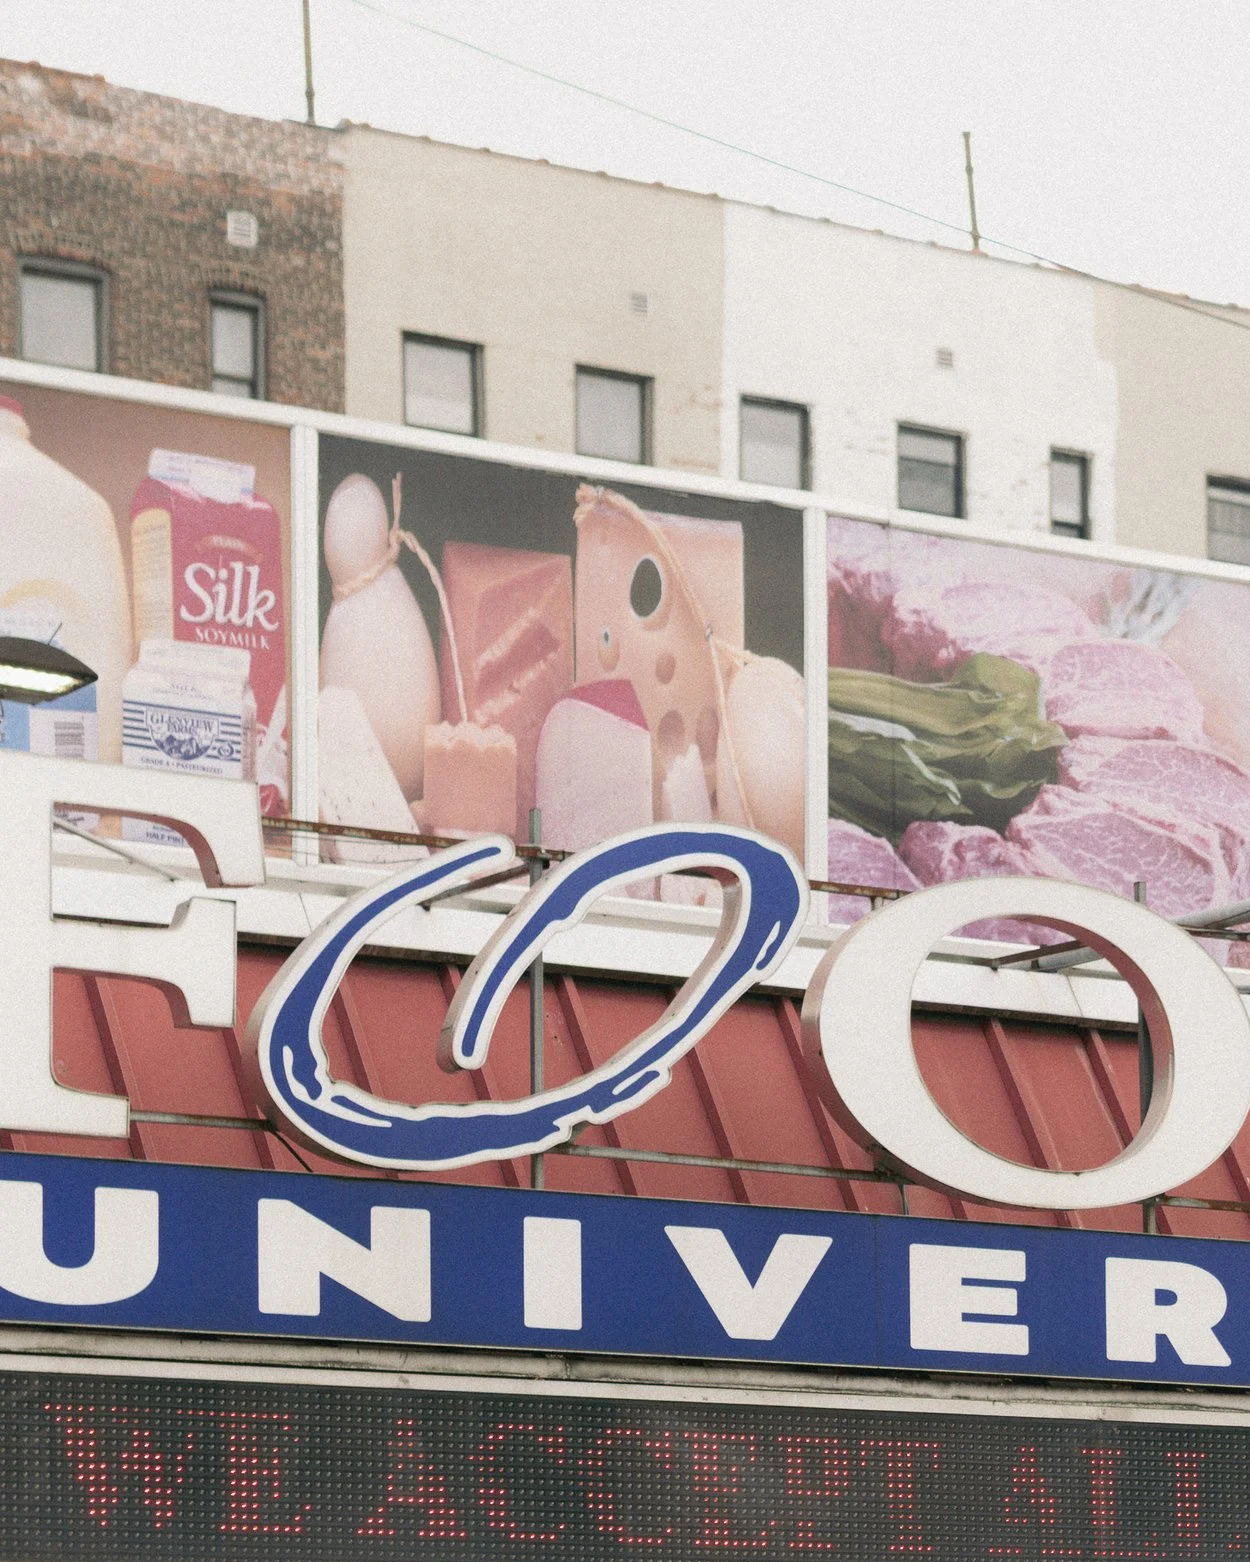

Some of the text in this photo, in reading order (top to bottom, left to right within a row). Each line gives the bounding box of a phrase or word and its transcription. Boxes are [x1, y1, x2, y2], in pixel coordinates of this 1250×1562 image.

[180, 562, 279, 631] Silk
[195, 627, 269, 650] SOYMILK
[150, 711, 214, 734] GLENVIEW
